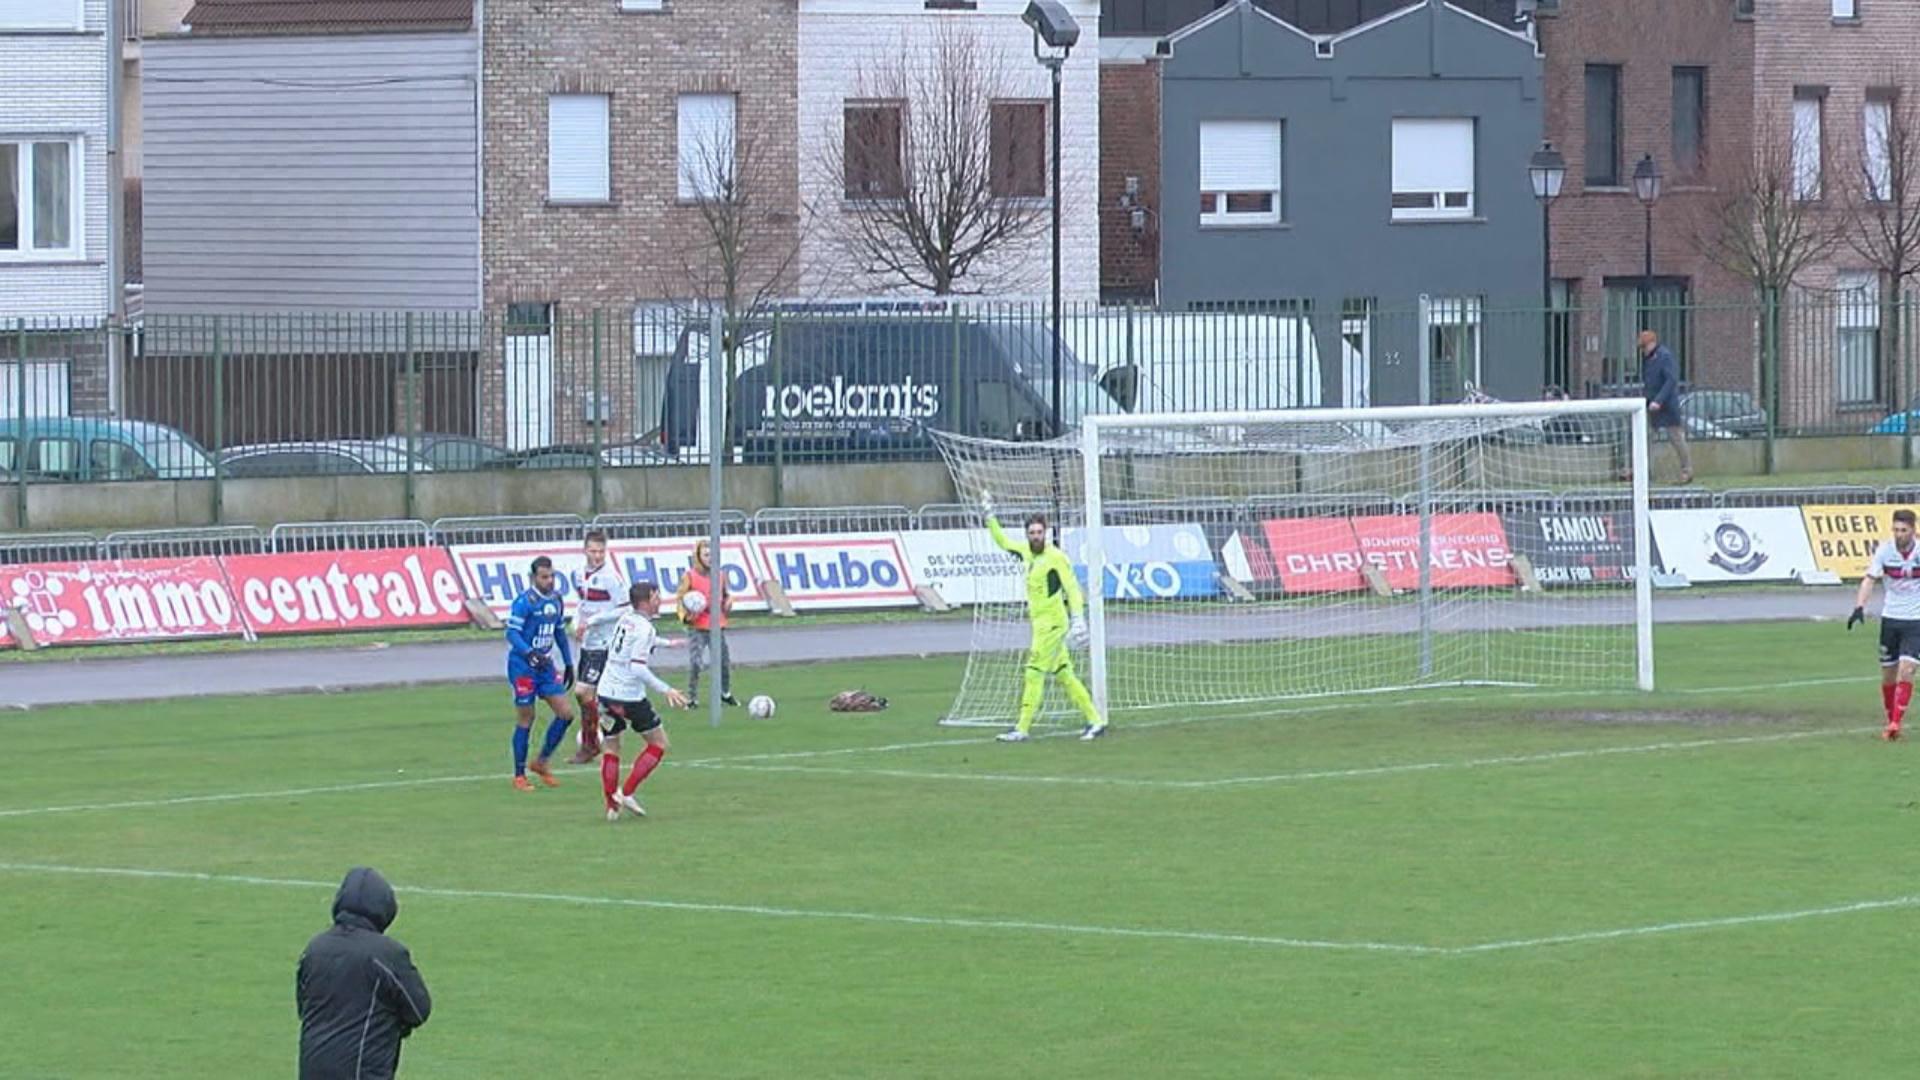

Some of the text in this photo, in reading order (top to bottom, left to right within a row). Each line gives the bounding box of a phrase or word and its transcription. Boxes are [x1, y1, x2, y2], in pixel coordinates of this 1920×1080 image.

[762, 375, 939, 417] roelants
[1362, 533, 1499, 547] BOUWONERNEMING
[1811, 514, 1879, 534] TIGER
[625, 555, 748, 593] Huo
[775, 551, 900, 593] Hubo
[927, 554, 944, 565] DE
[83, 554, 463, 631] immo centrale
